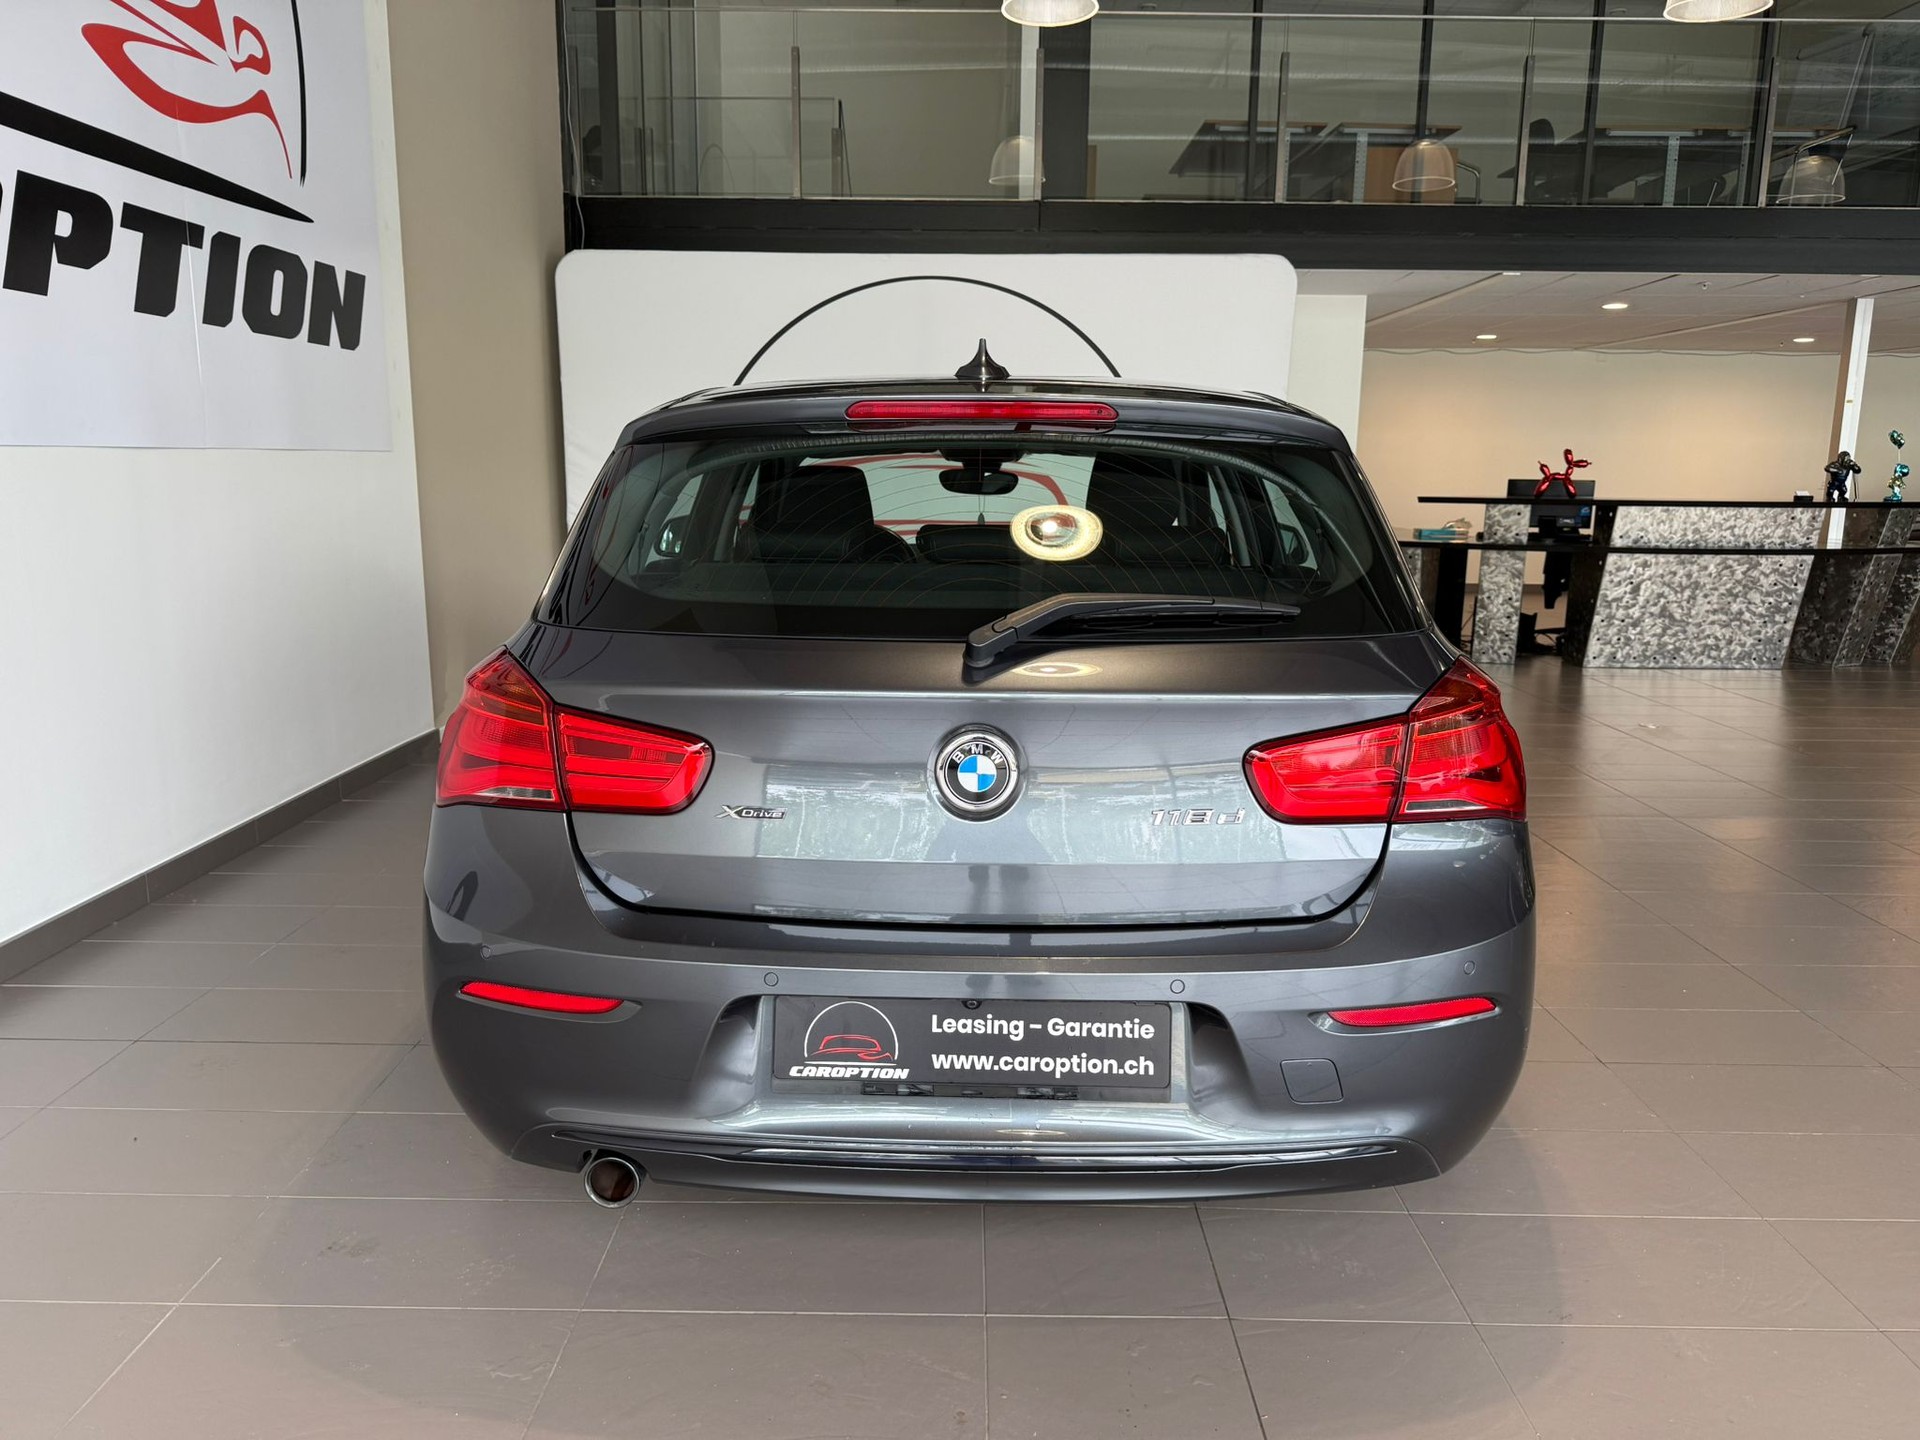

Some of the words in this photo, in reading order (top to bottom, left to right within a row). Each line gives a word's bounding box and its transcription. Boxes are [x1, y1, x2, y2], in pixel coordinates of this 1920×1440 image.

[0, 169, 366, 351] PTION
[952, 743, 1004, 764] BMW
[931, 1014, 1025, 1042] Leasing
[1047, 1016, 1155, 1040] Garantie
[789, 1065, 910, 1080] CAROPTION
[931, 1051, 1155, 1079] www.caroption.ch
